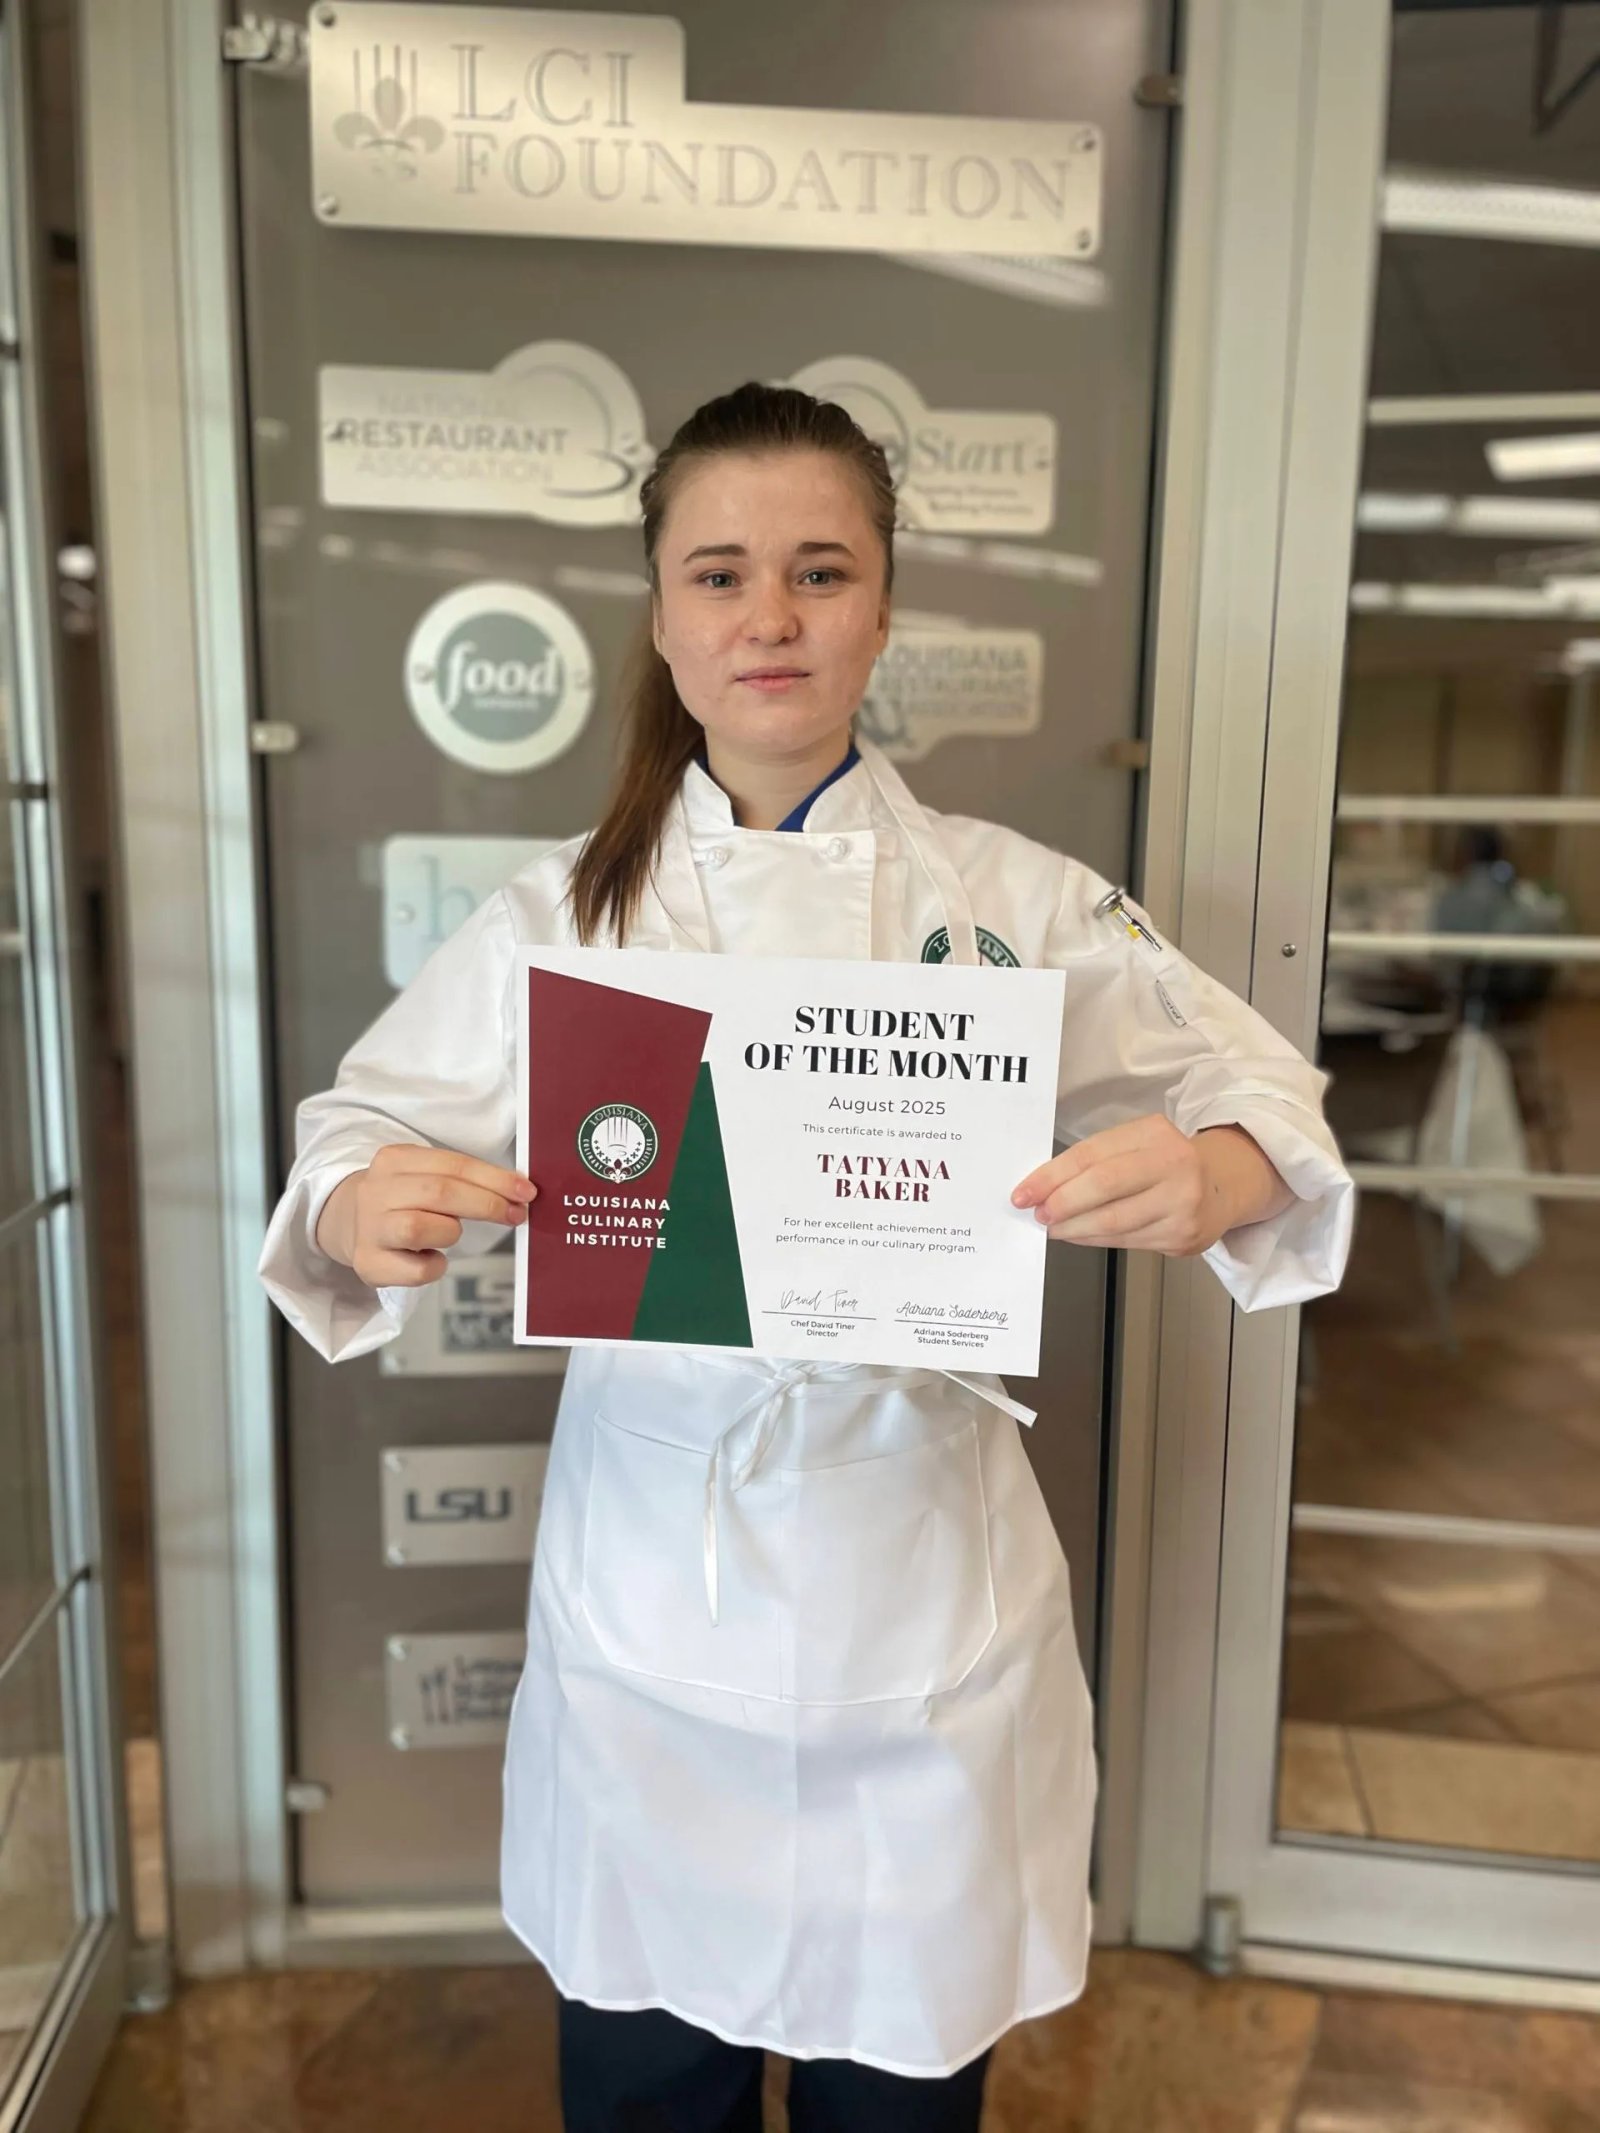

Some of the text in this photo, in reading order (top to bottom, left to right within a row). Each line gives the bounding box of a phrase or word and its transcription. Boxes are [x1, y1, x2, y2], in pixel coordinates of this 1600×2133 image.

[450, 44, 635, 129] LCI
[452, 131, 1072, 222] FOUNDATION
[335, 417, 569, 454] RESTAURANT
[443, 640, 561, 711] food
[795, 1005, 975, 1041] STUDENT
[744, 1042, 1031, 1083] OF THE MONTH
[828, 1096, 946, 1115] August 2025
[589, 1107, 648, 1130] LOUISIANA
[802, 1123, 962, 1141] This certificate is awarded to
[817, 1154, 951, 1180] TATYANA
[835, 1178, 930, 1202] BAKER
[563, 1195, 671, 1211] LOUISIANA
[568, 1214, 666, 1229] CULINARY
[784, 1217, 971, 1236] For her excellent achievement and
[566, 1232, 667, 1248] INSTITUTE
[776, 1234, 845, 1245] performance
[848, 1236, 858, 1245] in
[861, 1239, 879, 1247] our
[882, 1240, 925, 1252] culinary
[780, 1289, 822, 1311] David
[896, 1301, 1009, 1325] Adriana Soderberg
[790, 1320, 856, 1330] Chef David Tiner
[806, 1329, 839, 1338] Director
[913, 1328, 989, 1341] Adriana Soderberg
[917, 1336, 984, 1348] Student Services
[405, 1487, 512, 1523] LSU
